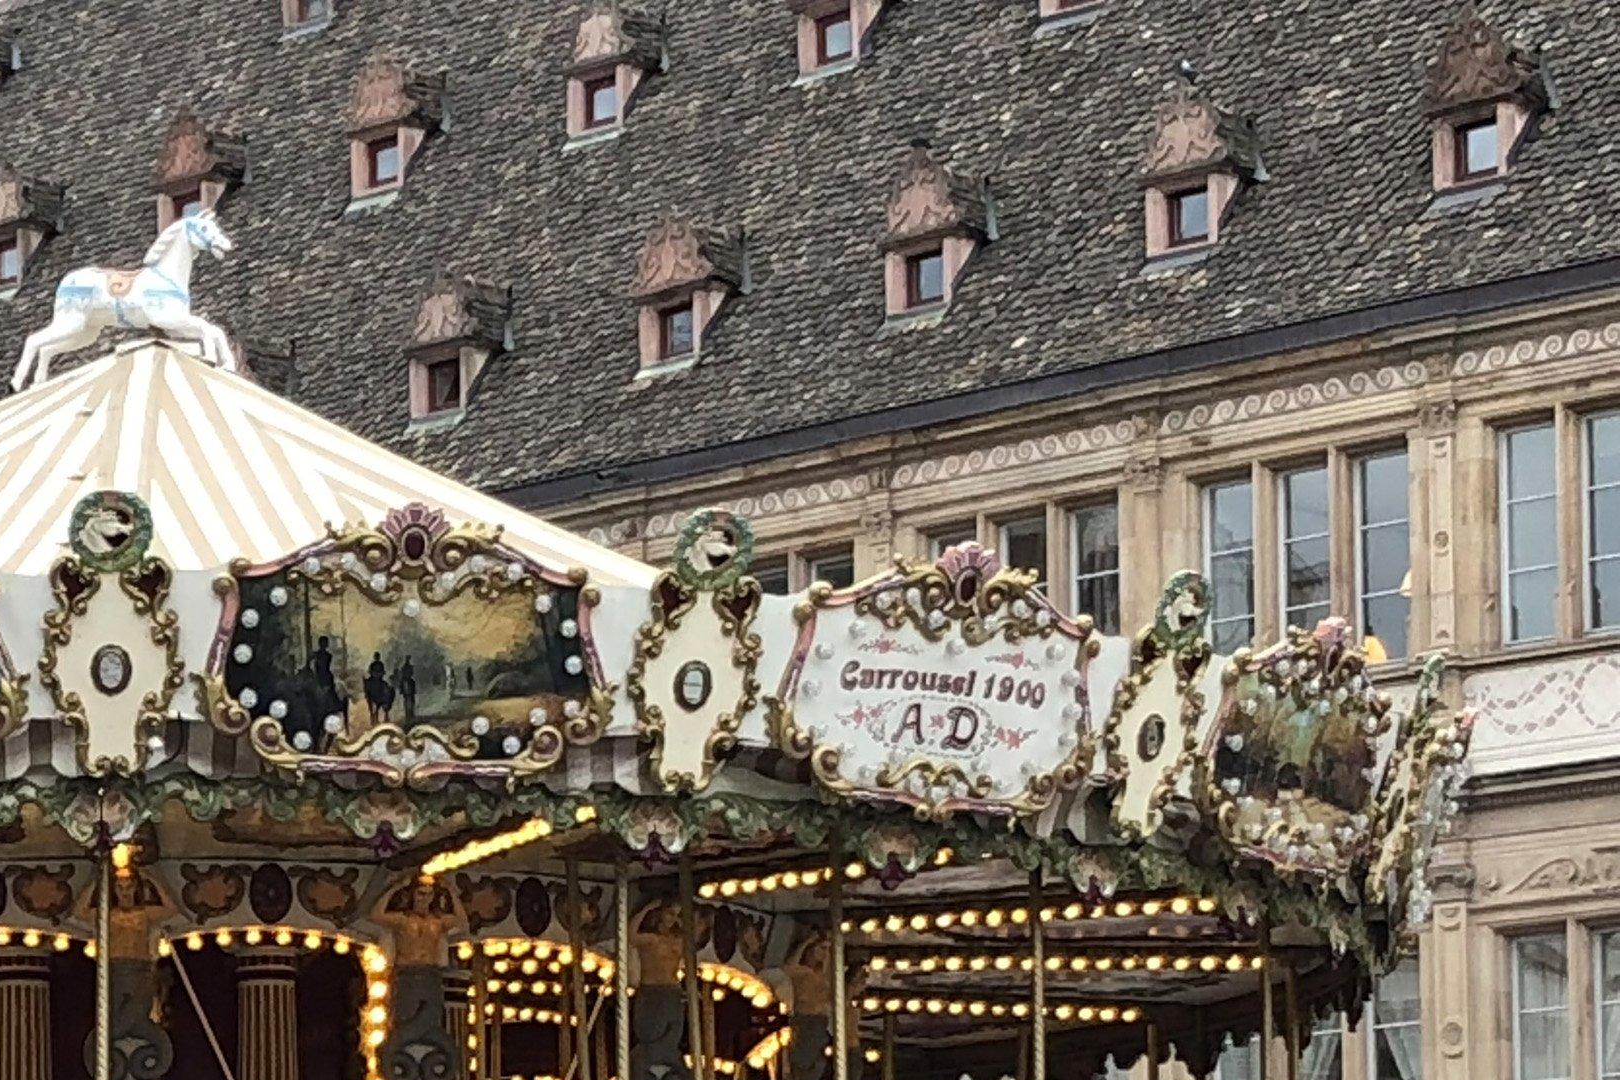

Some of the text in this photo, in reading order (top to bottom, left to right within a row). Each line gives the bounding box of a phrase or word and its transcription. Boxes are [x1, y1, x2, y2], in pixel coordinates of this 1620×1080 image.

[983, 674, 1047, 709] 1900
[891, 702, 980, 750] A D
